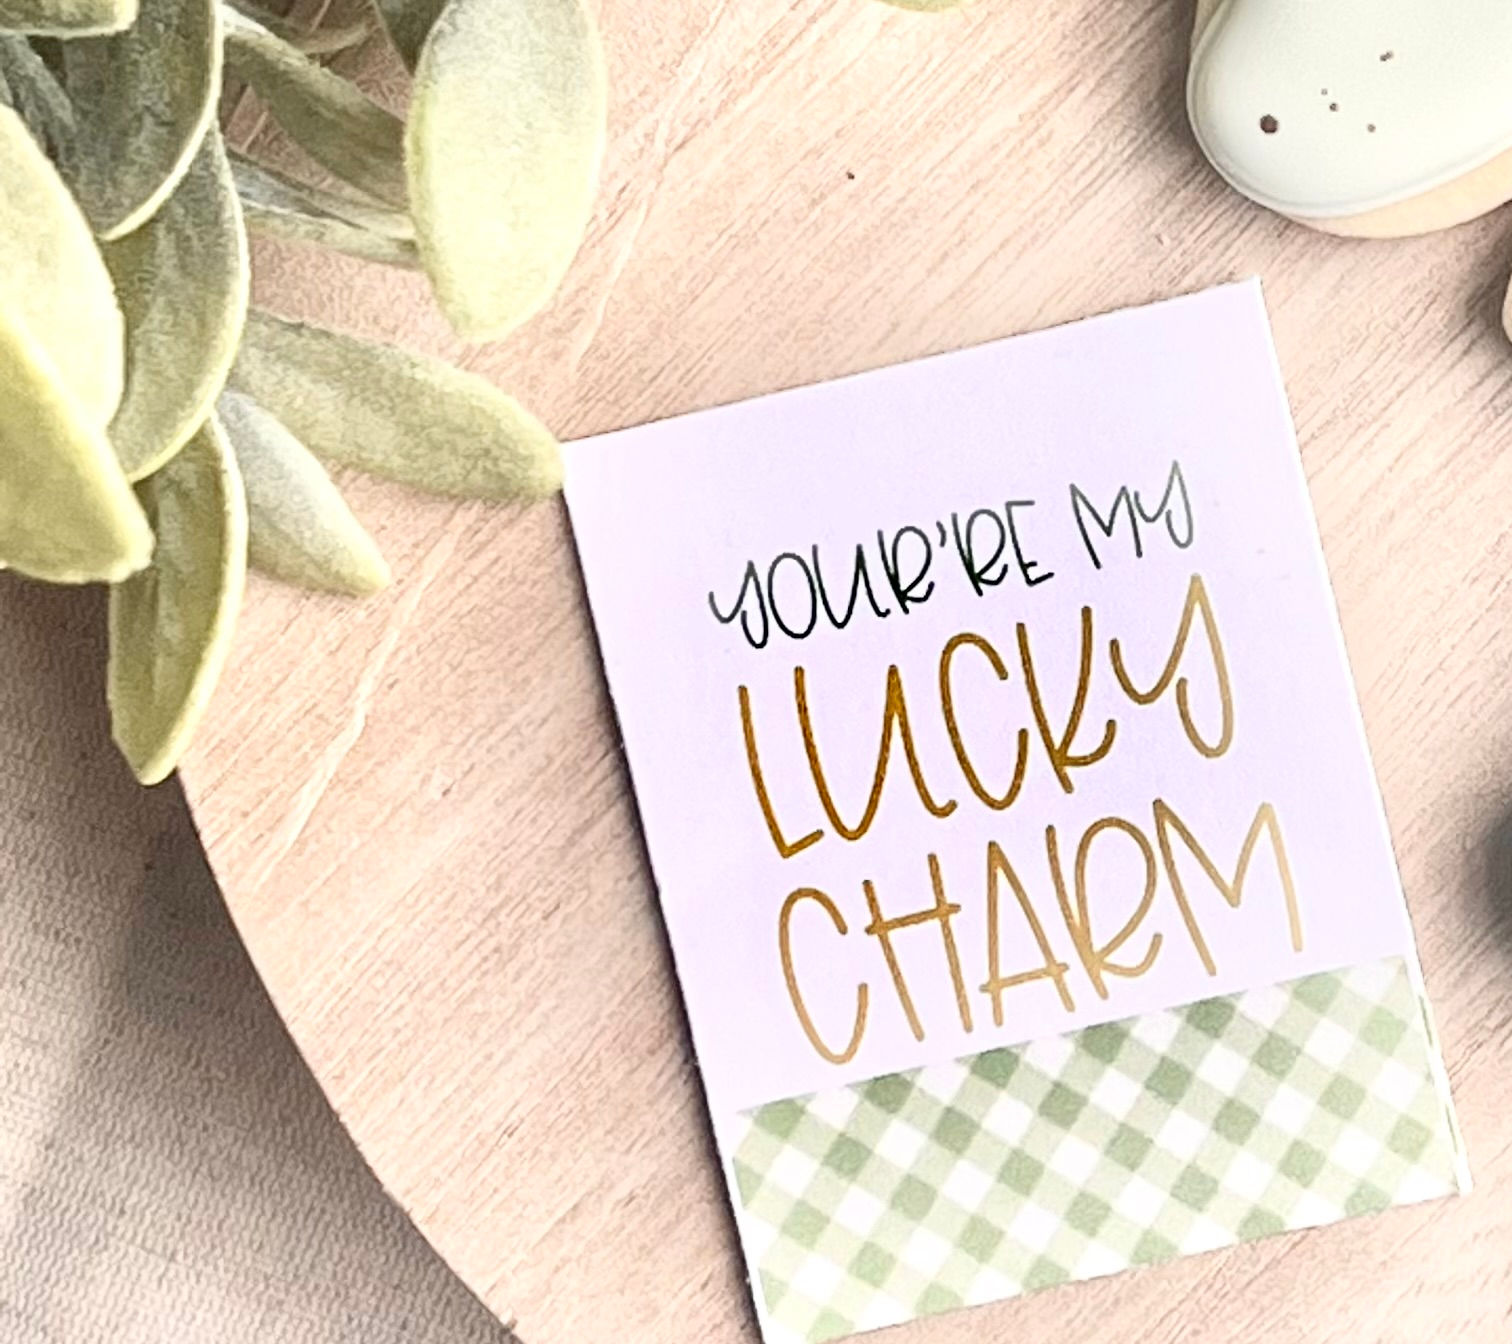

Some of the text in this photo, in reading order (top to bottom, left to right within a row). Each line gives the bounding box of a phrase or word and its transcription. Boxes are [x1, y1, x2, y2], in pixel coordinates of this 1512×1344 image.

[1070, 460, 1194, 568] MY
[738, 573, 1234, 859] LUCKY
[778, 798, 1304, 1065] CHARM
